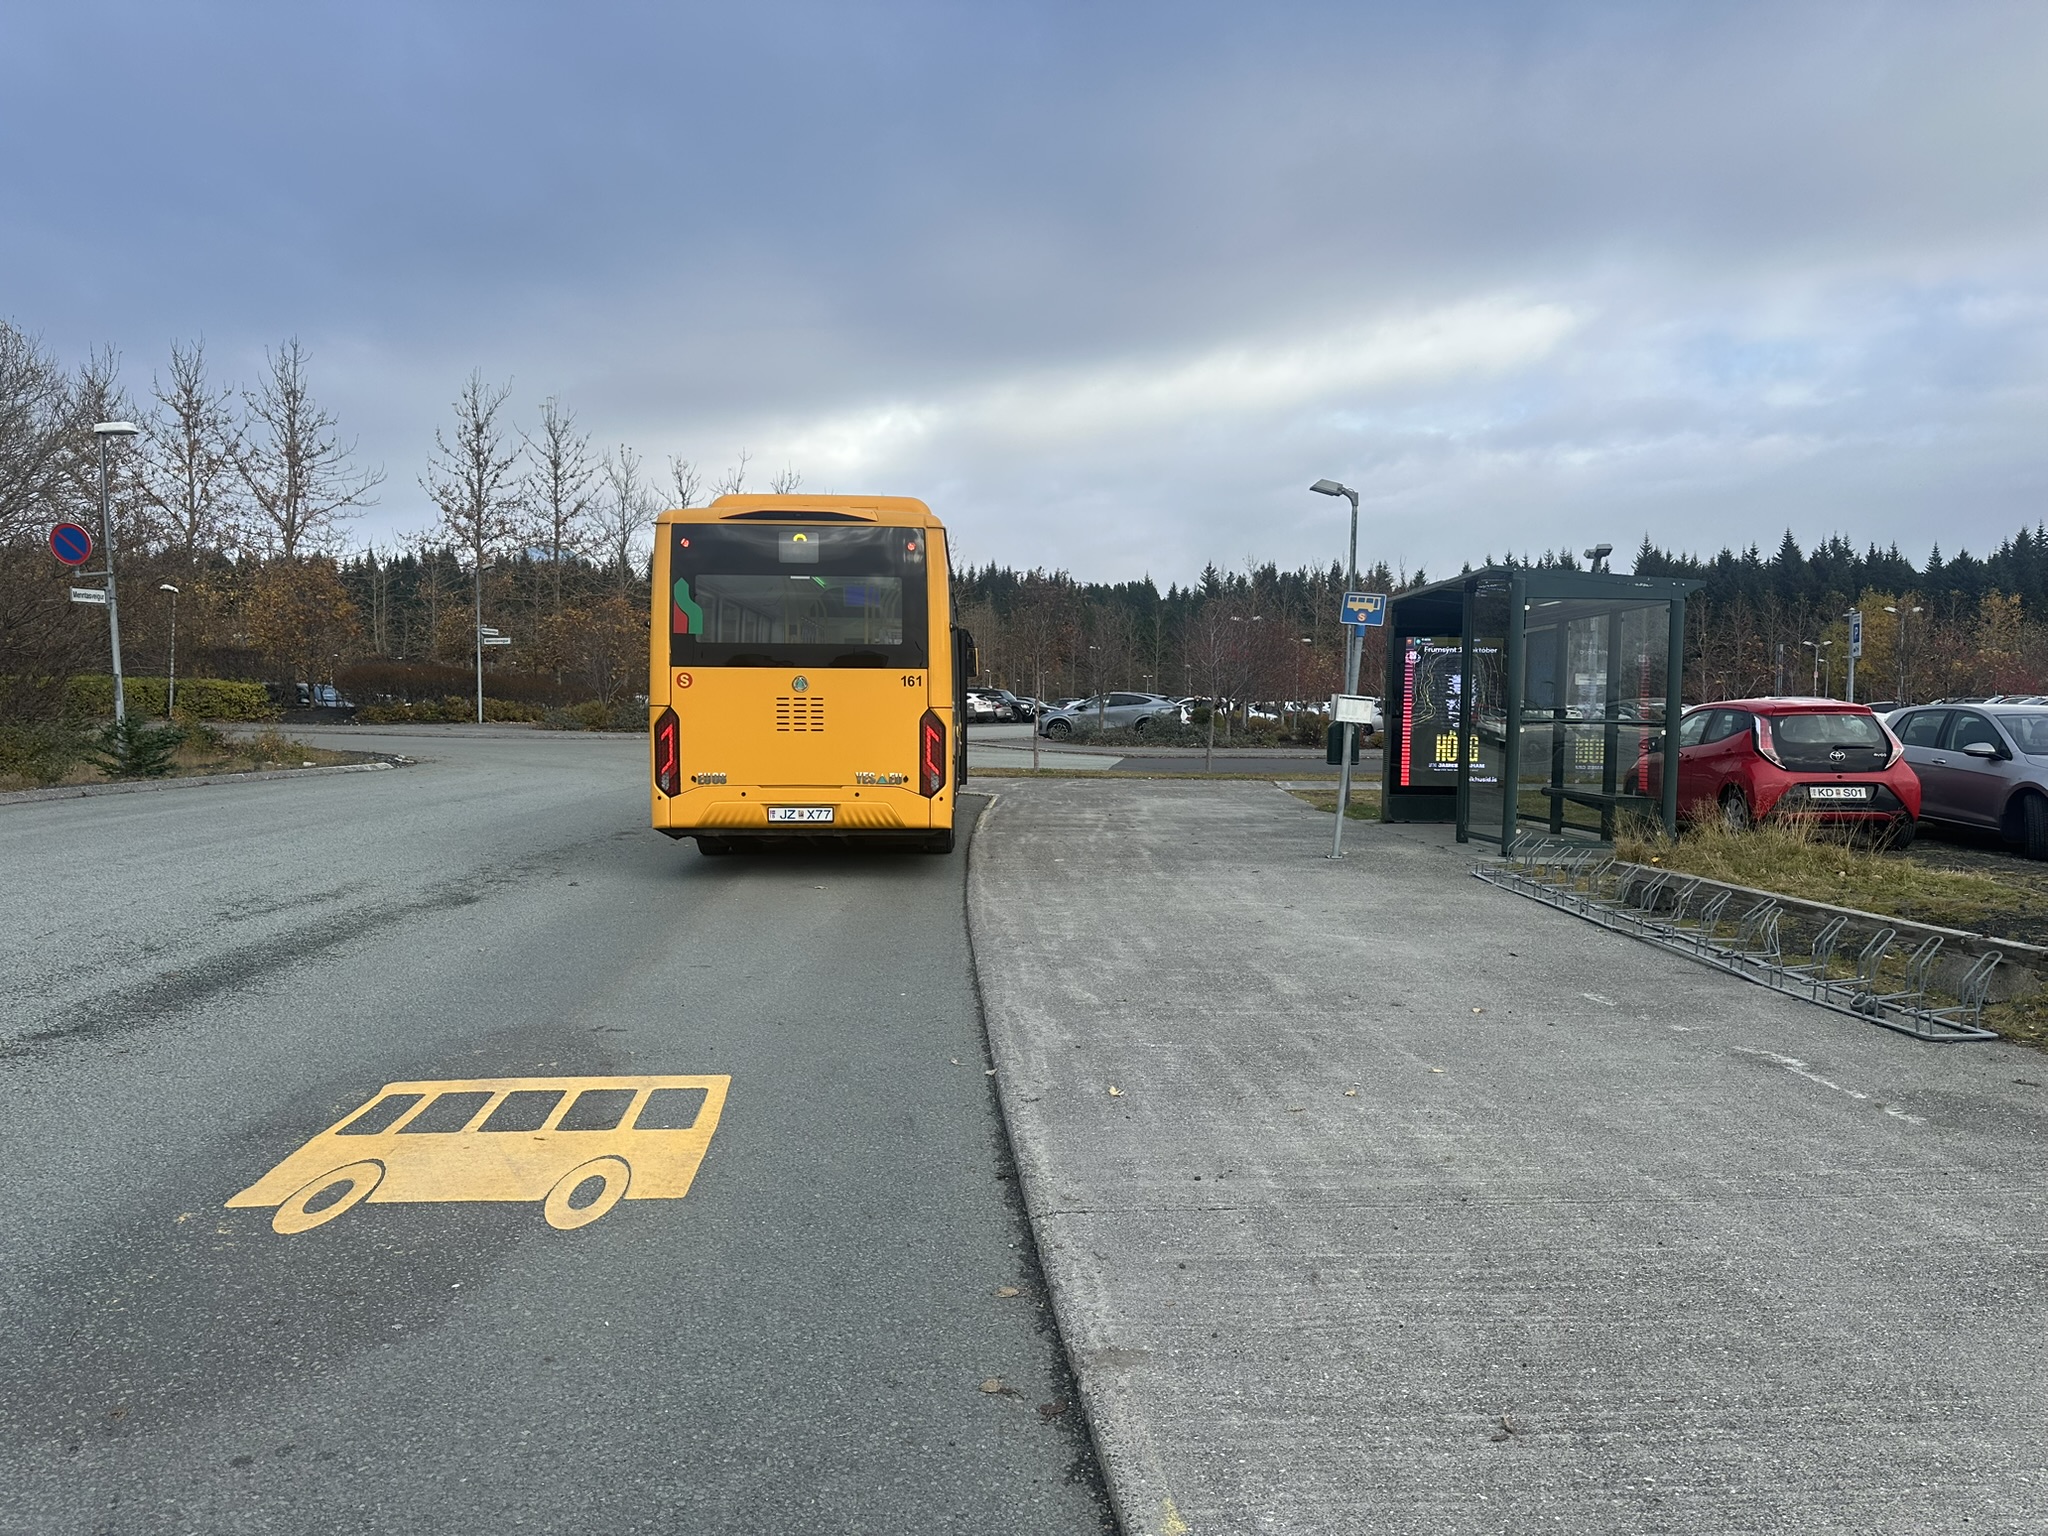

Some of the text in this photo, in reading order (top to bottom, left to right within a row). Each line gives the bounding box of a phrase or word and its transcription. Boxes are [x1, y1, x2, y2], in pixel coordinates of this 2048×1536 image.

[680, 674, 690, 687] S
[900, 675, 922, 687] 161
[1435, 730, 1479, 762] HÖG
[1818, 789, 1863, 797] KD S01
[779, 809, 796, 819] JZ
[806, 809, 832, 819] X77
